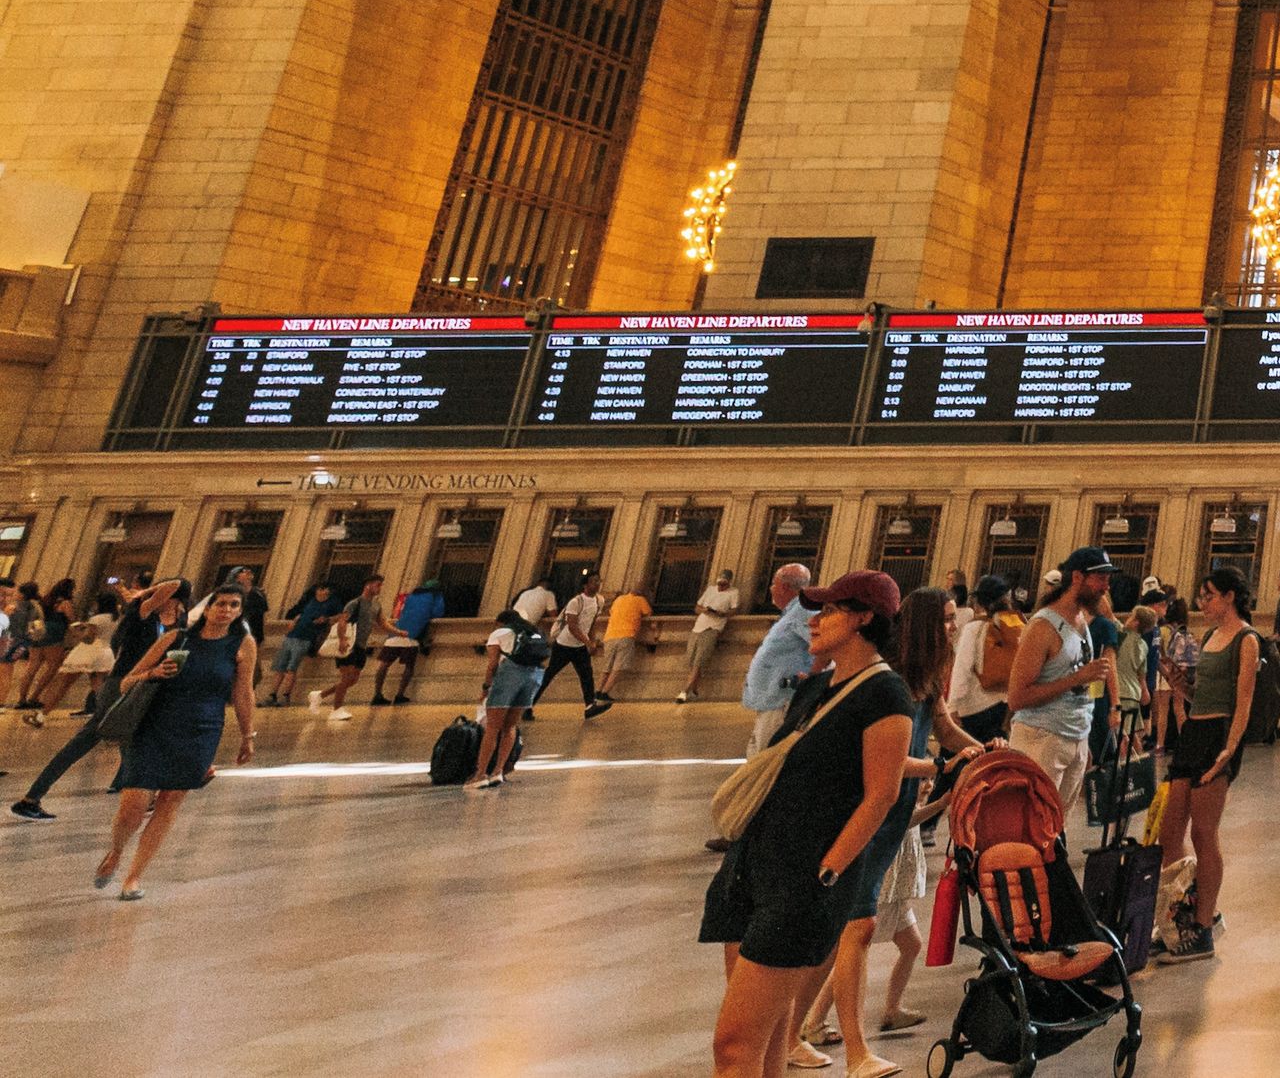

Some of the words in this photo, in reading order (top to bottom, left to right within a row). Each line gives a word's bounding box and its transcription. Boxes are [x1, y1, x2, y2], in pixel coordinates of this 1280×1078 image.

[620, 317, 651, 328] NEW
[651, 317, 696, 328] HAVEN
[697, 317, 727, 328] LINE
[728, 316, 807, 327] DEPARTURES
[956, 315, 988, 326] NEW
[987, 315, 1031, 326] HAVEN
[1033, 315, 1063, 325] LINE
[1064, 314, 1143, 325] DEPARTURES
[281, 319, 314, 331] NEW
[313, 319, 359, 330] HAVEN
[359, 318, 389, 330] LINE
[390, 318, 471, 329] DEPARTURES
[920, 334, 938, 342] TRK
[947, 334, 1006, 342] DESTINATION
[1262, 331, 1268, 339] If
[212, 339, 235, 347] TIME
[243, 339, 261, 347] TRK
[269, 339, 330, 347] DESTINATION
[551, 337, 573, 345] TIME
[582, 337, 600, 345] TRK
[609, 337, 669, 345] DESTINATION
[690, 336, 731, 344] REMARKS
[1023, 358, 1064, 366] STAMFORD
[1259, 356, 1278, 364] Alert
[365, 363, 380, 371] 1ST
[284, 376, 324, 384] NORWALK
[1267, 381, 1280, 389] call
[245, 415, 266, 423] NEW
[327, 414, 378, 422] BRIDGEPORT
[383, 414, 397, 422] 1ST
[363, 474, 443, 490] VENDING
[447, 474, 538, 490] MACHINES
